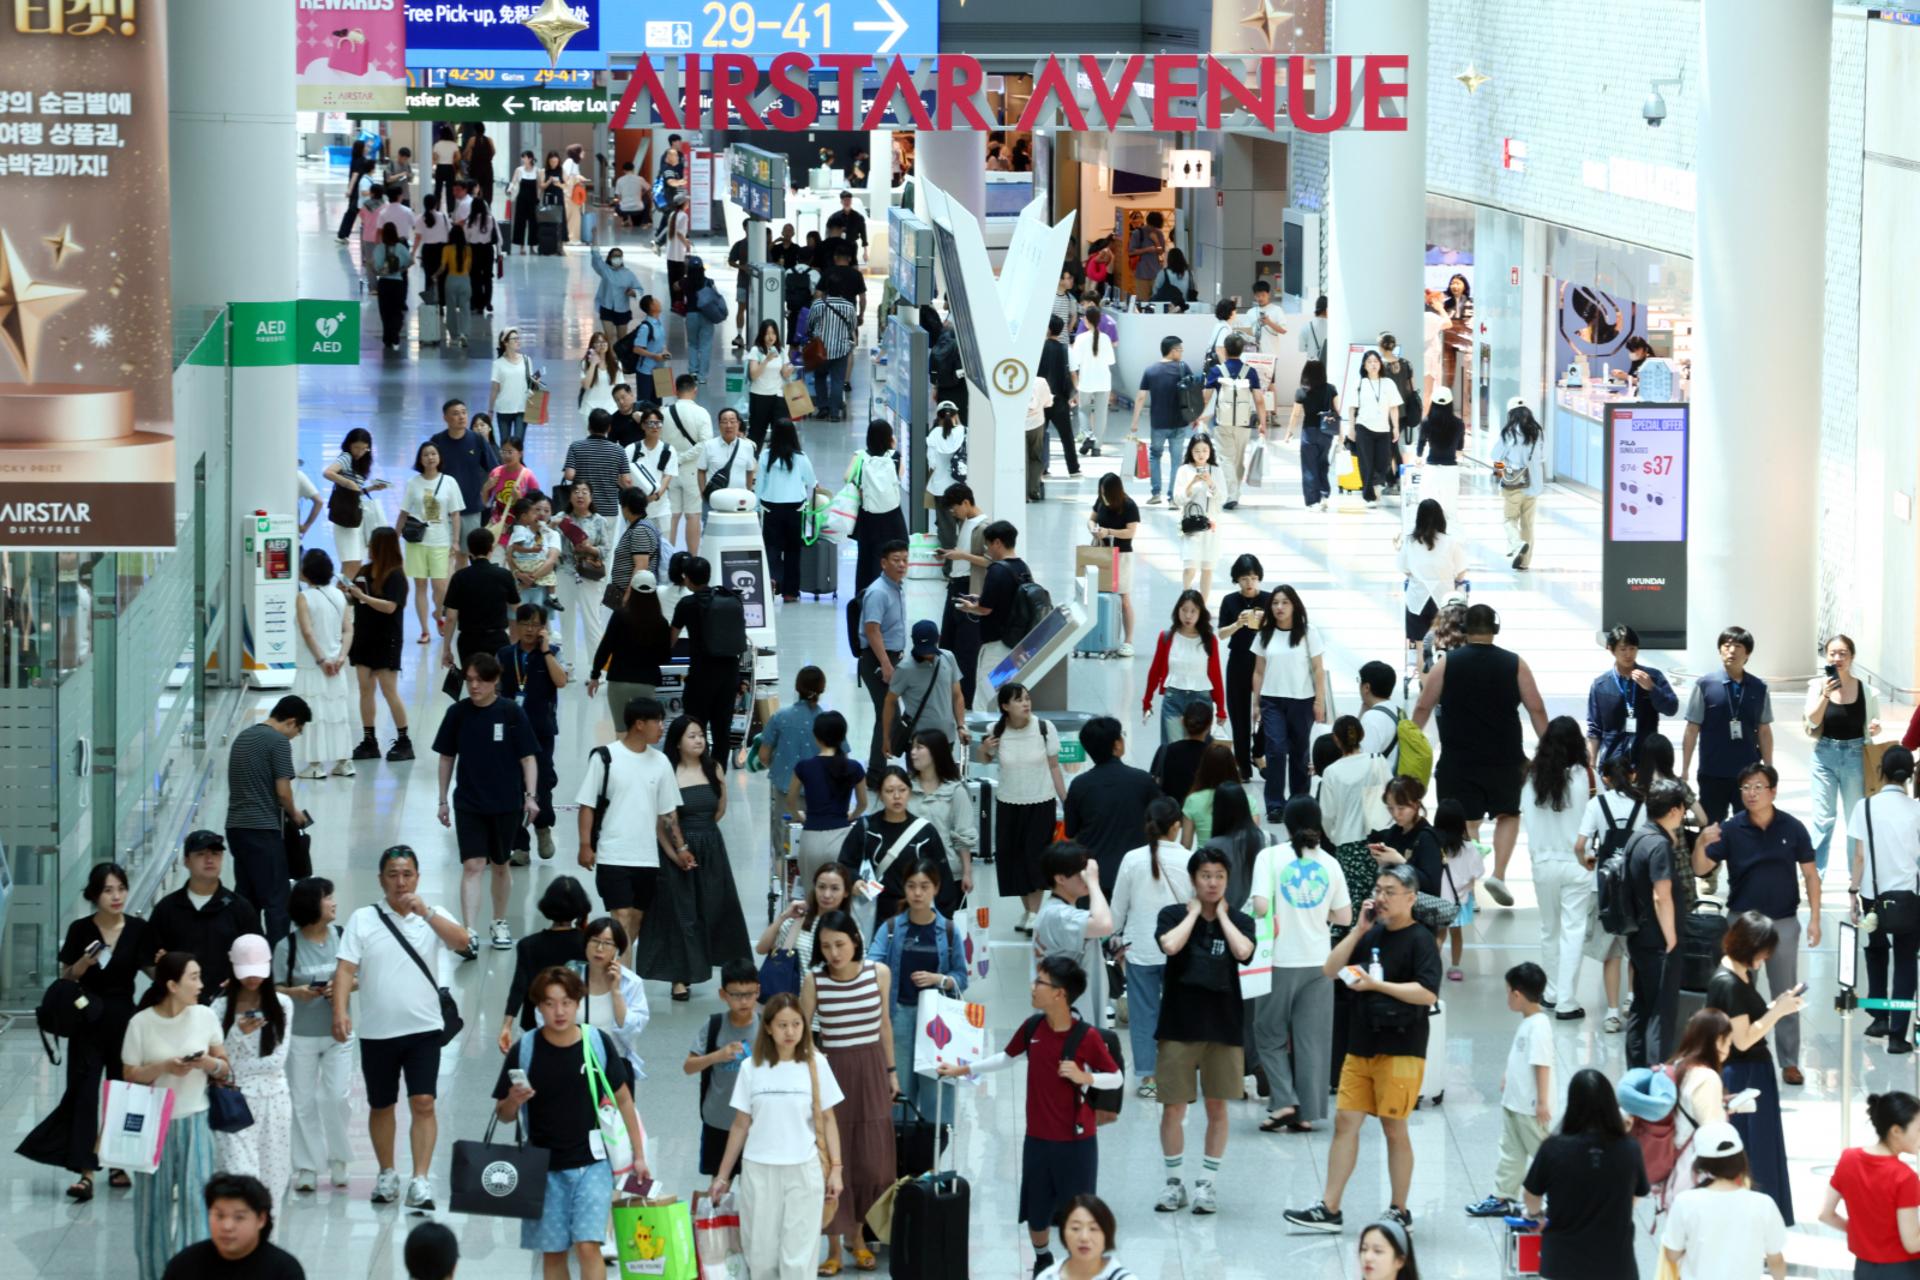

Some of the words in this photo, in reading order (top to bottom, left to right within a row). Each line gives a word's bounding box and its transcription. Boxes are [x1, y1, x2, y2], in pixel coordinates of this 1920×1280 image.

[436, 5, 497, 27] Pick-up,
[702, 2, 831, 48] 29-41
[608, 51, 991, 132] AIRSTAR
[1016, 52, 1409, 133] AVENUE
[39, 91, 132, 115] 순금별에
[445, 94, 480, 107] Desk
[529, 96, 584, 112] Transfer
[49, 123, 125, 148] 상품권,
[256, 320, 287, 334] AED
[312, 341, 342, 352] AED
[1633, 420, 1661, 430] SPECIAL
[0, 503, 91, 522] AIRSTAR
[9, 526, 81, 534] DUTYFREE
[1627, 577, 1666, 585] HYUNDAI
